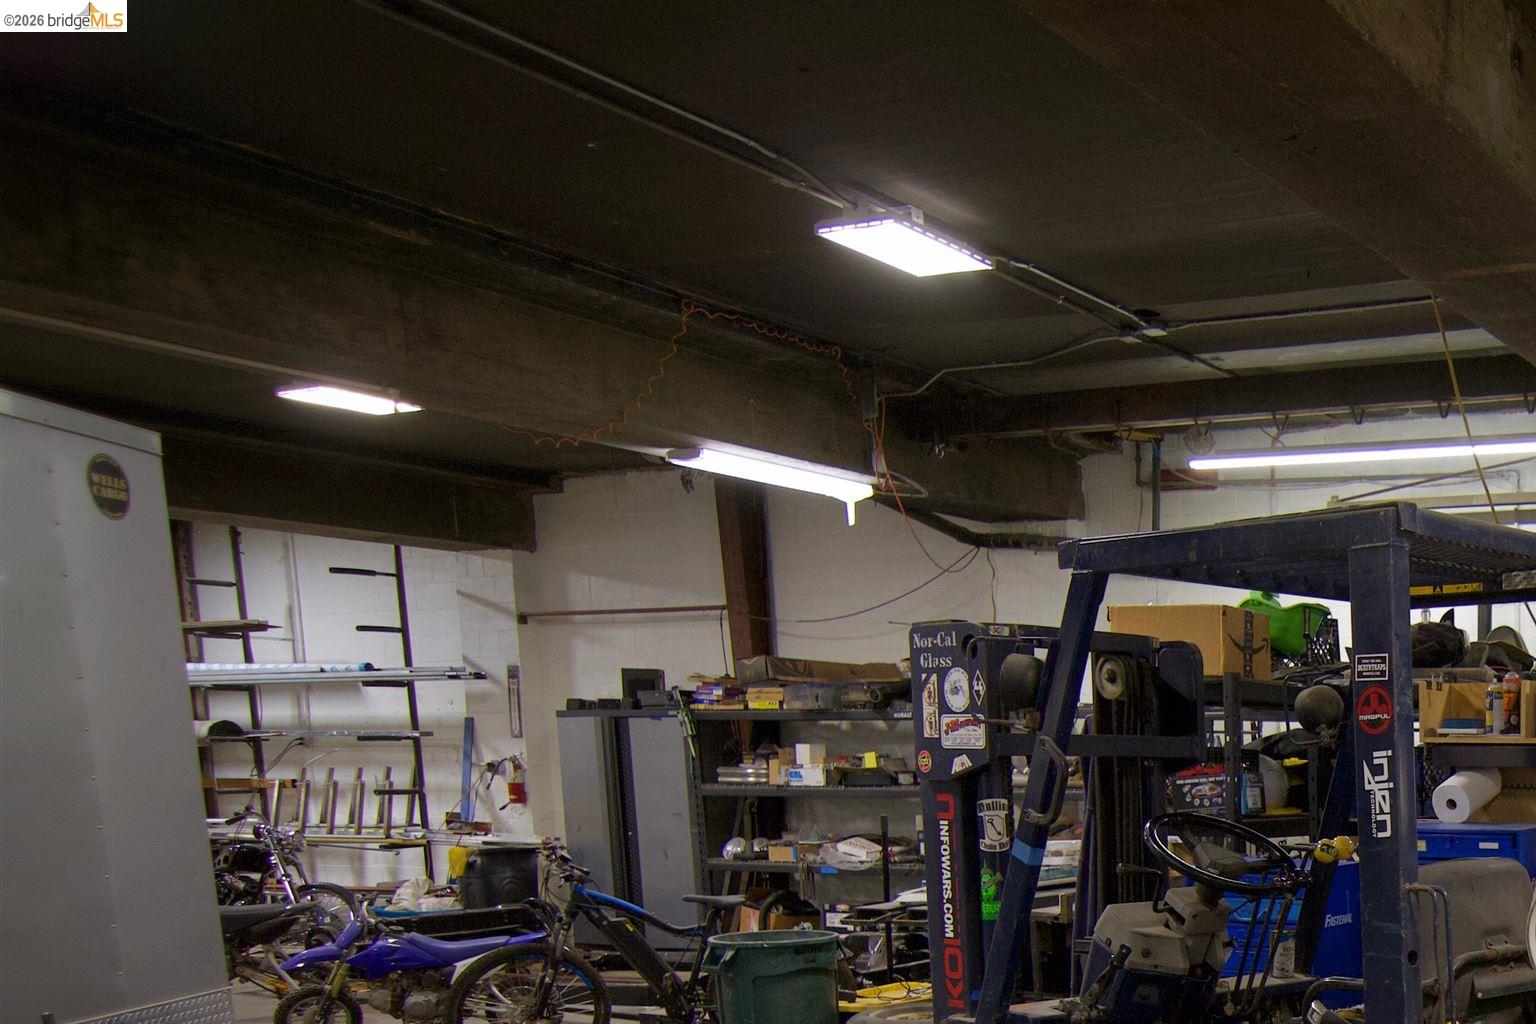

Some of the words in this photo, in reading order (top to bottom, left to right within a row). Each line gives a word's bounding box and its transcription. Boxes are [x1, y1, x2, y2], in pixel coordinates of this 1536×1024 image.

[912, 630, 958, 649] Nor-Cal
[920, 652, 953, 668] Glass
[1358, 713, 1391, 721] MAGPUL
[1369, 790, 1377, 838] TECHNOLOGY
[938, 819, 955, 938] INFOWARS.COM
